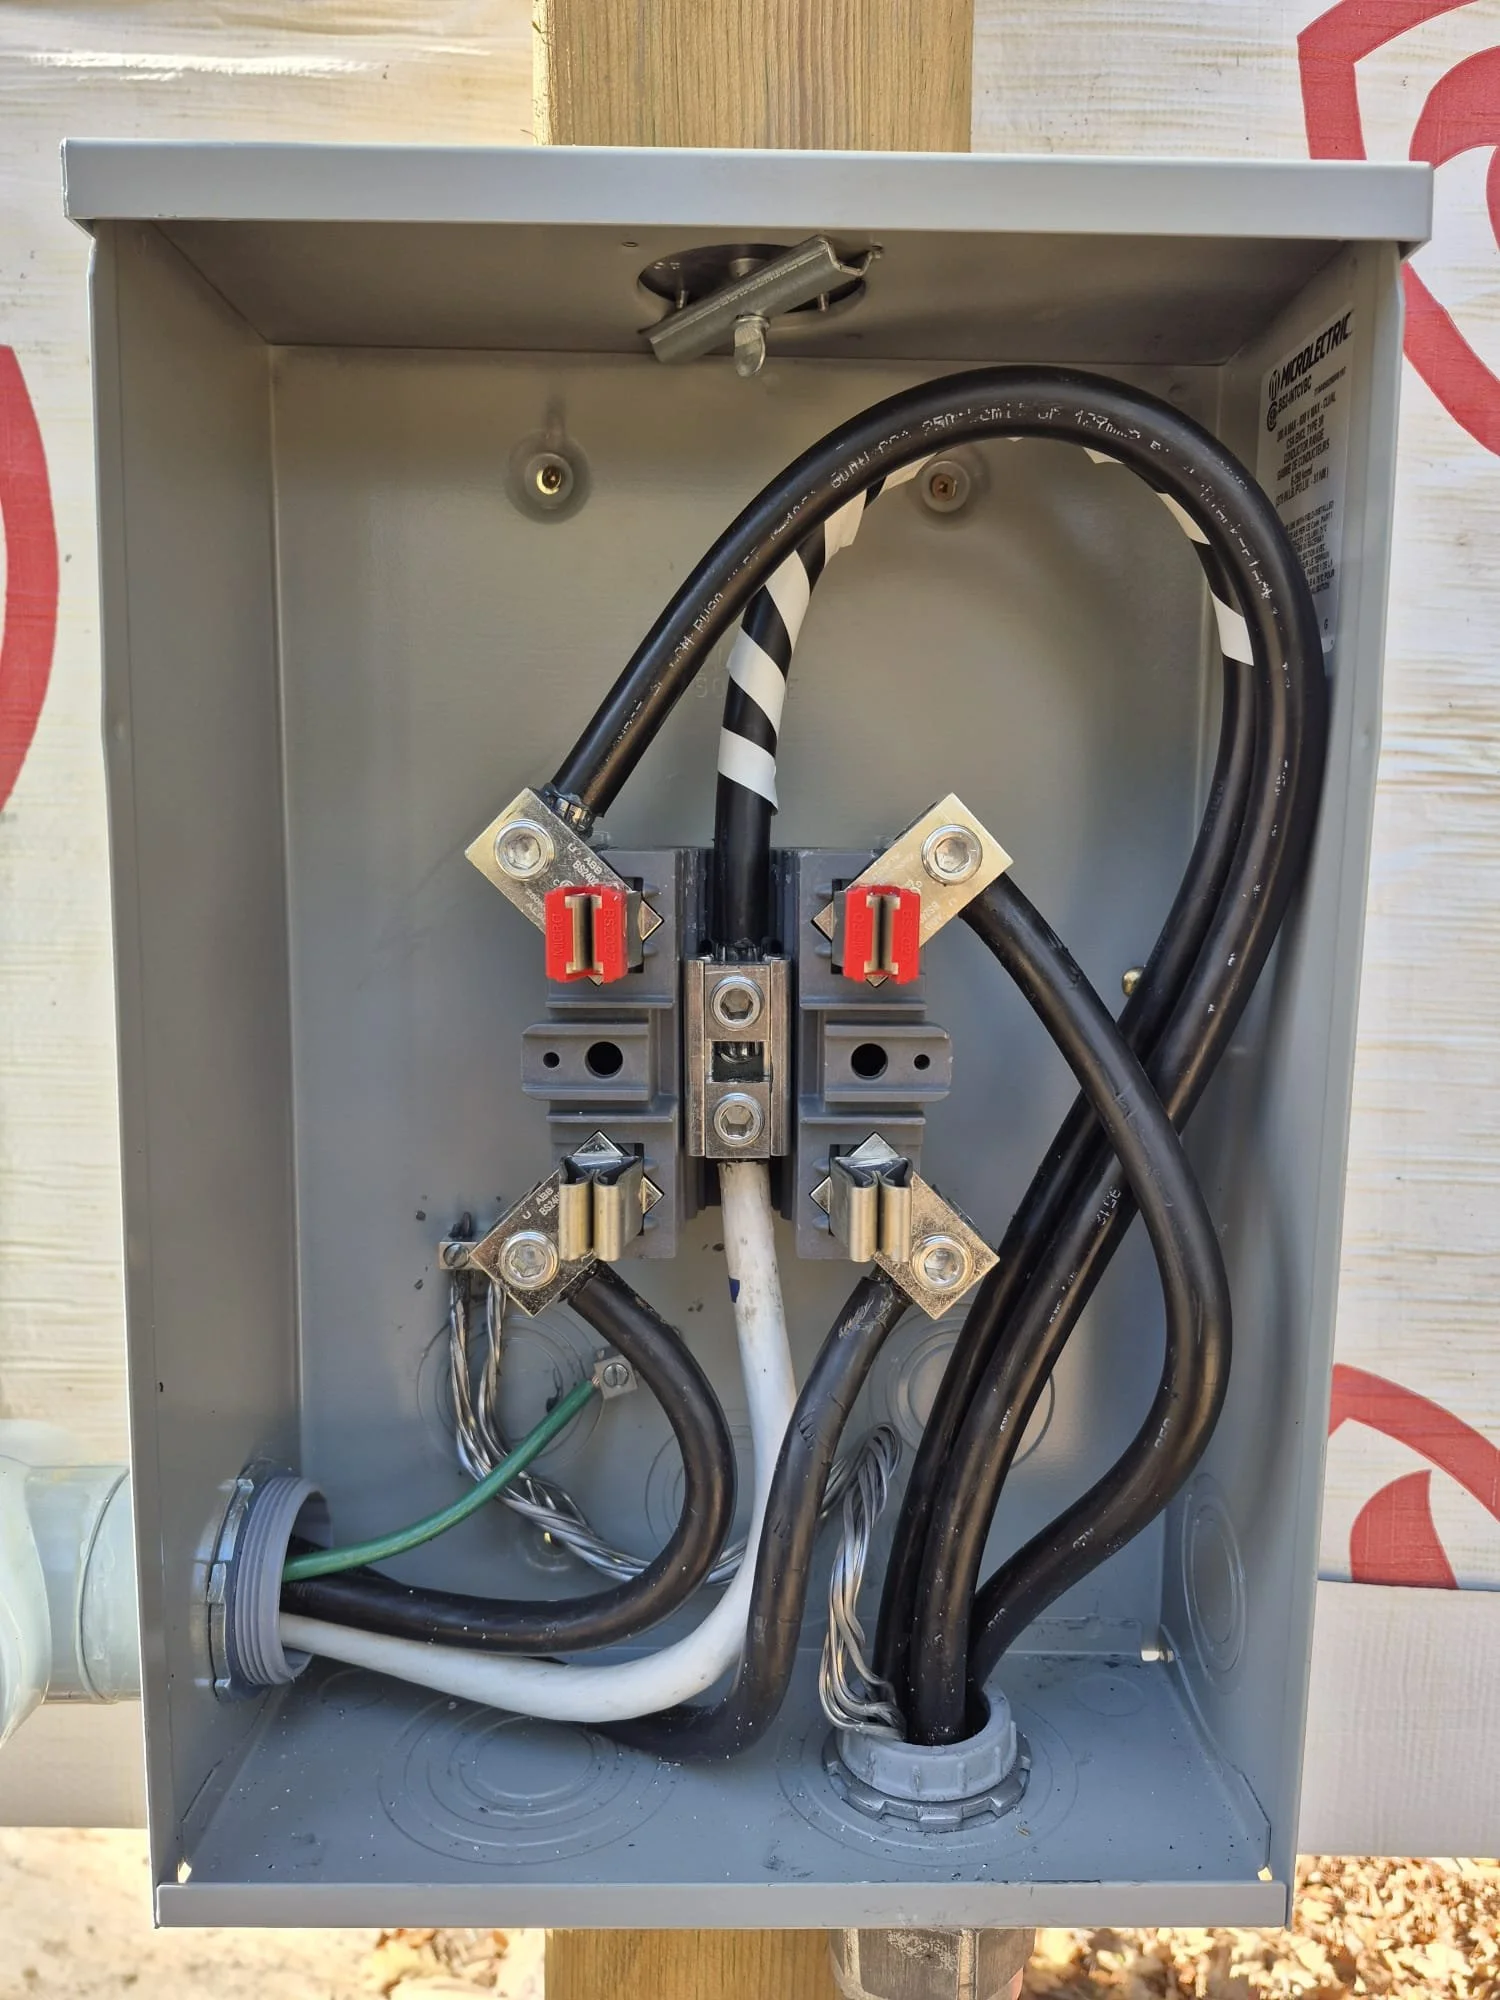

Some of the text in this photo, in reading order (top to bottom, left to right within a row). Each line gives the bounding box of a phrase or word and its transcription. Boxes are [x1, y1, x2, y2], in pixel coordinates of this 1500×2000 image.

[1280, 310, 1351, 390] MICROLECTRIC
[1283, 427, 1324, 464] CONDUCTOR RANGE
[1292, 458, 1297, 471] DE
[1298, 438, 1329, 467] CONDUCTEURS
[584, 856, 603, 875] ABB
[552, 912, 565, 958] MICRO
[535, 1187, 554, 1205] ABB
